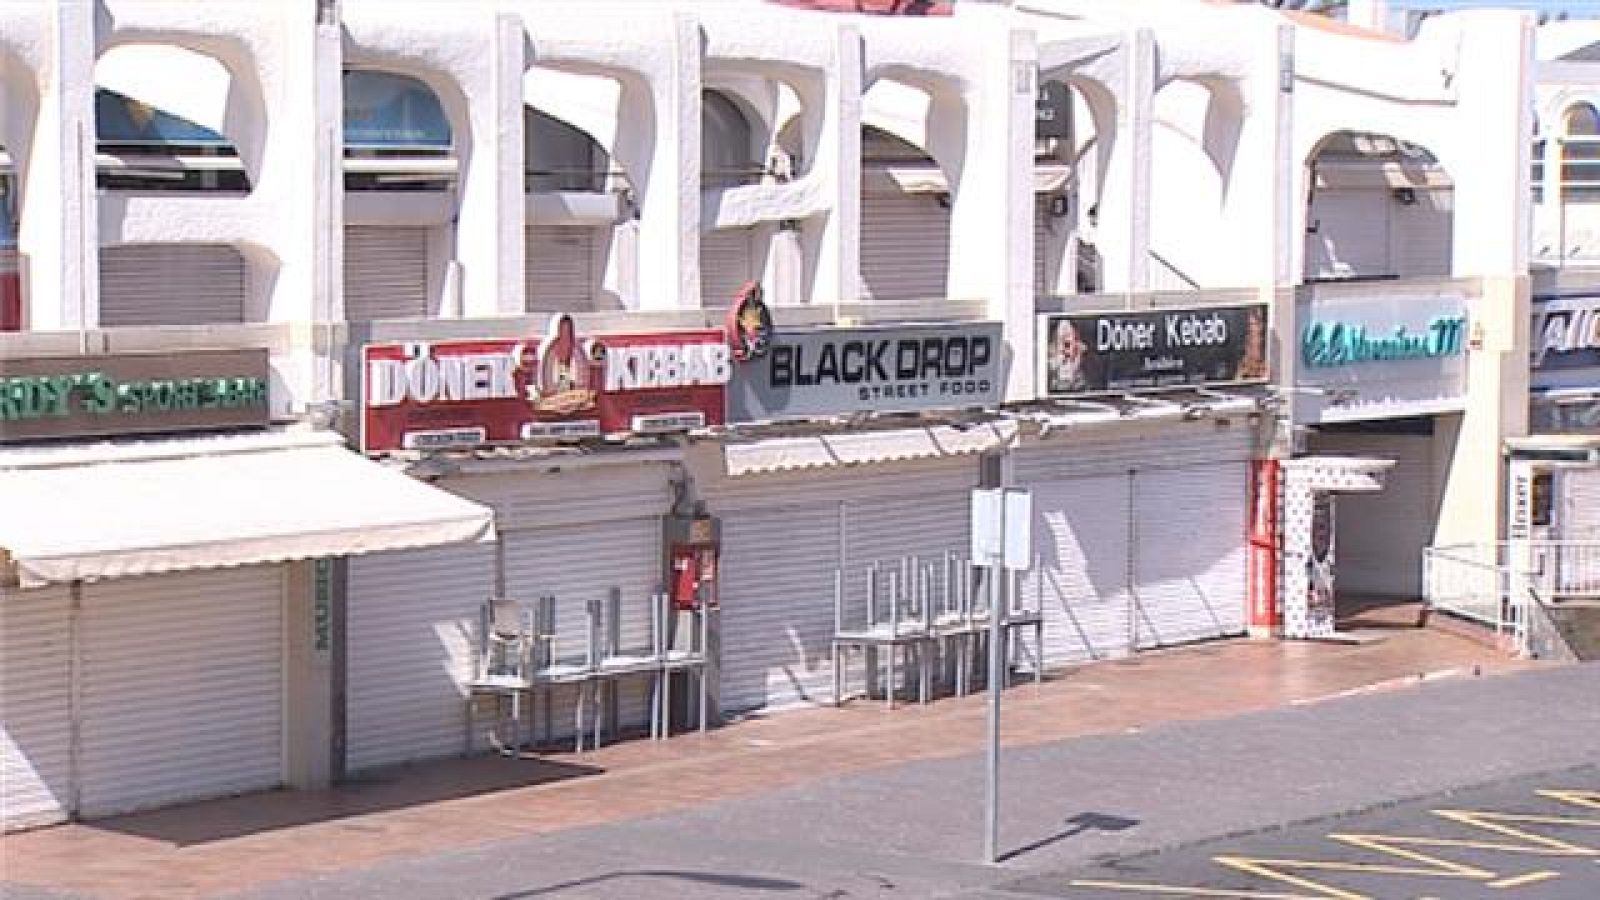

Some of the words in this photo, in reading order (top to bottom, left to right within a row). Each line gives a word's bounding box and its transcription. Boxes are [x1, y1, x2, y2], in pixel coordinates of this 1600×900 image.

[1097, 317, 1156, 352] Döner
[1164, 312, 1227, 346] Kebab
[605, 343, 732, 391] KEBAB
[769, 339, 892, 388] BLACK
[895, 335, 991, 380] DROP
[858, 382, 929, 401] STREET
[939, 379, 991, 396] FOOD
